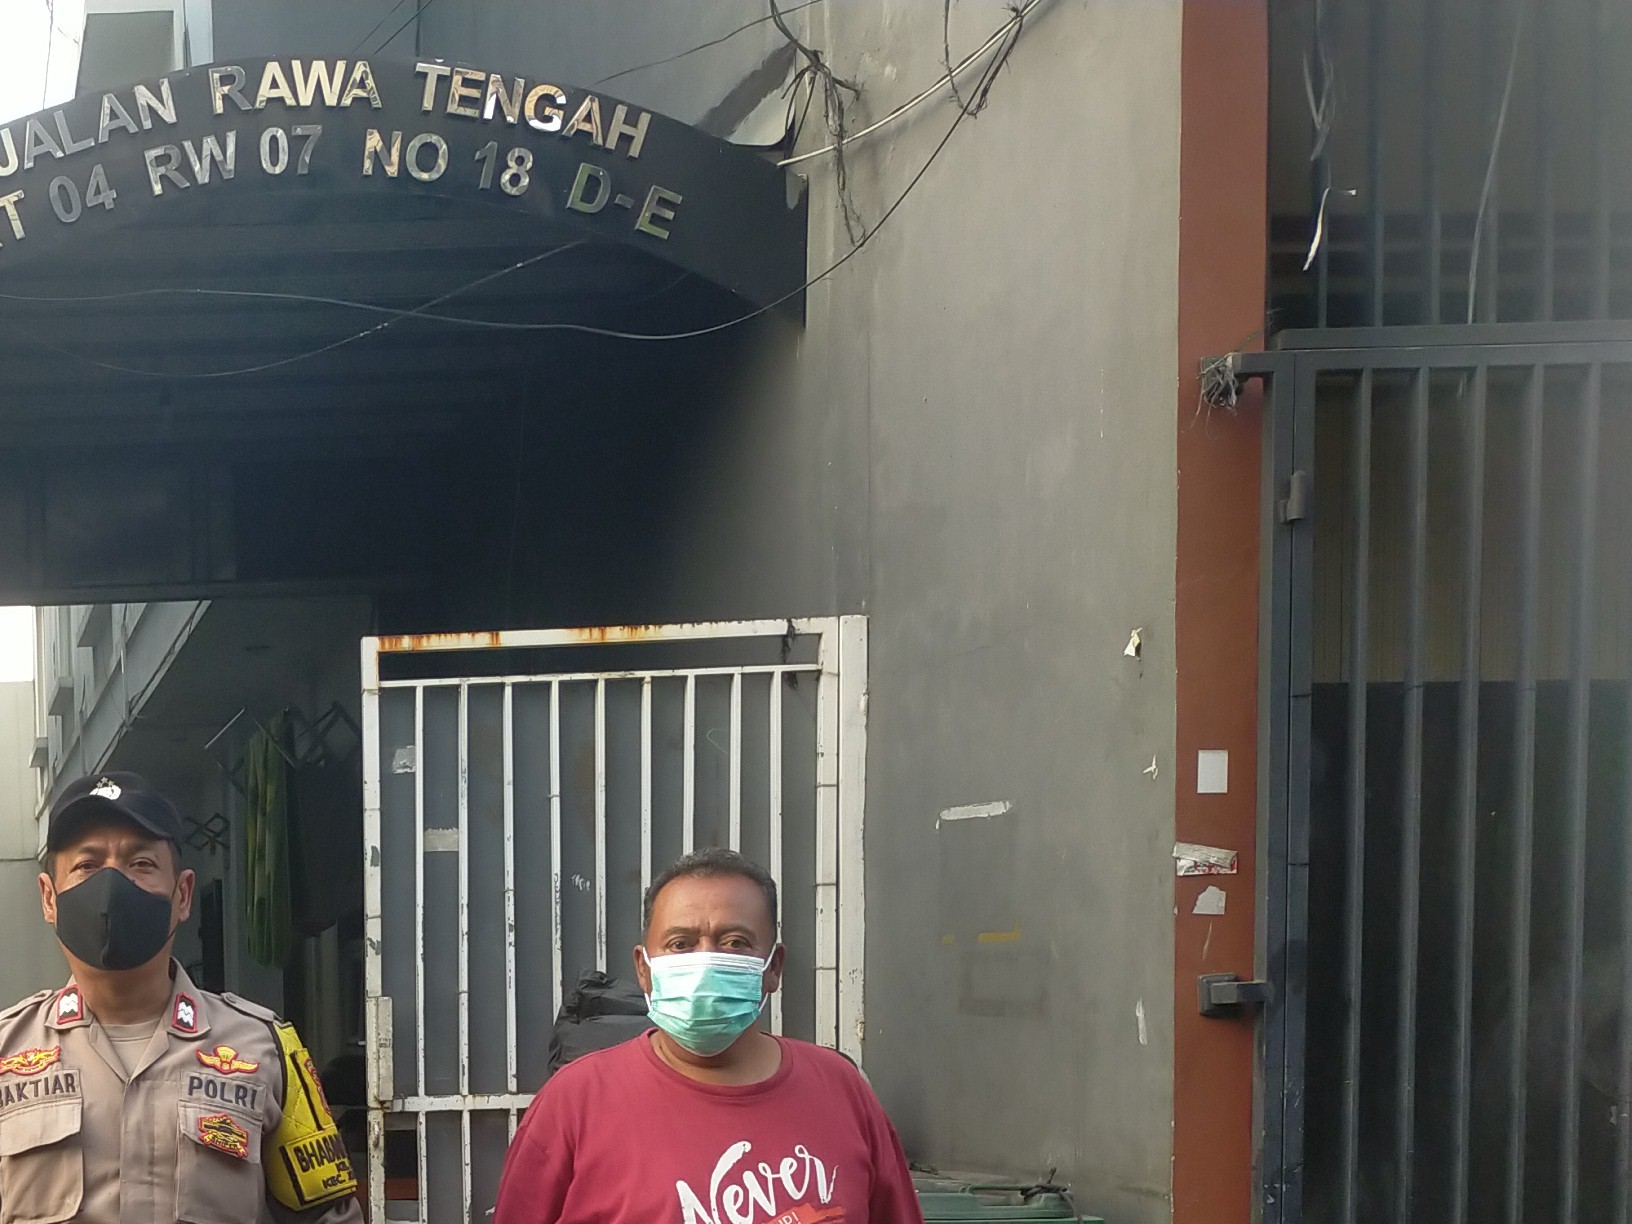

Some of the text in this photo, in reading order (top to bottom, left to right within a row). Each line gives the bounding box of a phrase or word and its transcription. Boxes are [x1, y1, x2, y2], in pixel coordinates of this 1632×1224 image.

[207, 59, 382, 115] RAWA
[415, 62, 651, 159] TENGAH
[48, 163, 117, 223] 04
[143, 129, 237, 197] RW
[259, 125, 323, 175] 07
[362, 128, 449, 183] NO
[474, 141, 533, 196] 18
[566, 162, 683, 240] D-E
[188, 1076, 257, 1110] POLRI
